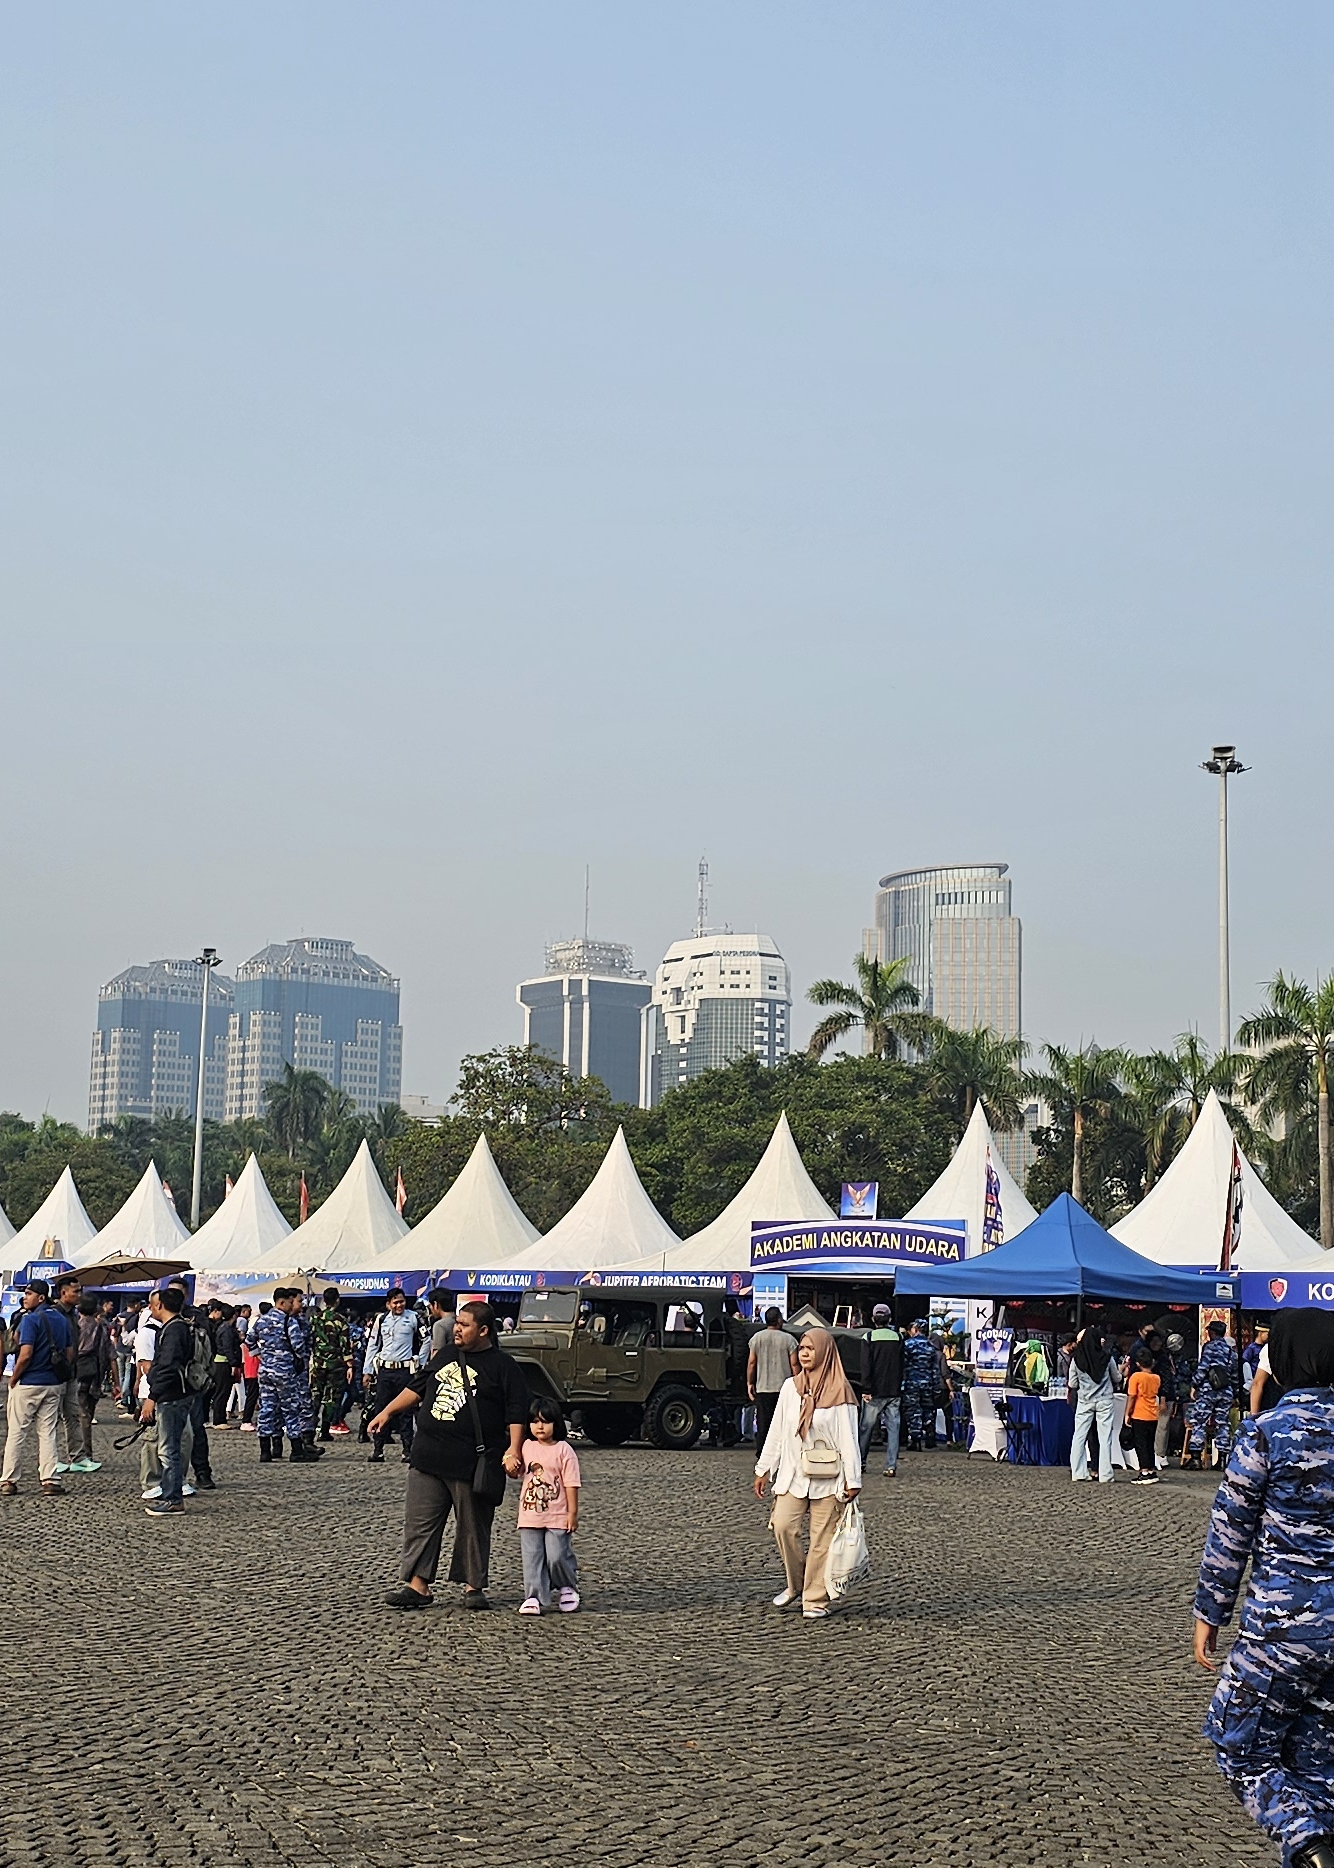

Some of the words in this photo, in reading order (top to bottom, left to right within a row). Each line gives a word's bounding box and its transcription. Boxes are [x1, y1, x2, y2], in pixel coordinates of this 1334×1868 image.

[753, 1232, 817, 1258] AKADEMI
[820, 1231, 901, 1250] ANGKATAN
[905, 1234, 960, 1260] UDARA
[339, 1278, 389, 1290] KOOPSUDNAS
[479, 1274, 531, 1286] KODIKLATAU
[602, 1276, 639, 1286] JUPITER
[641, 1276, 697, 1288] AEROBATIC
[697, 1276, 727, 1288] TEAM
